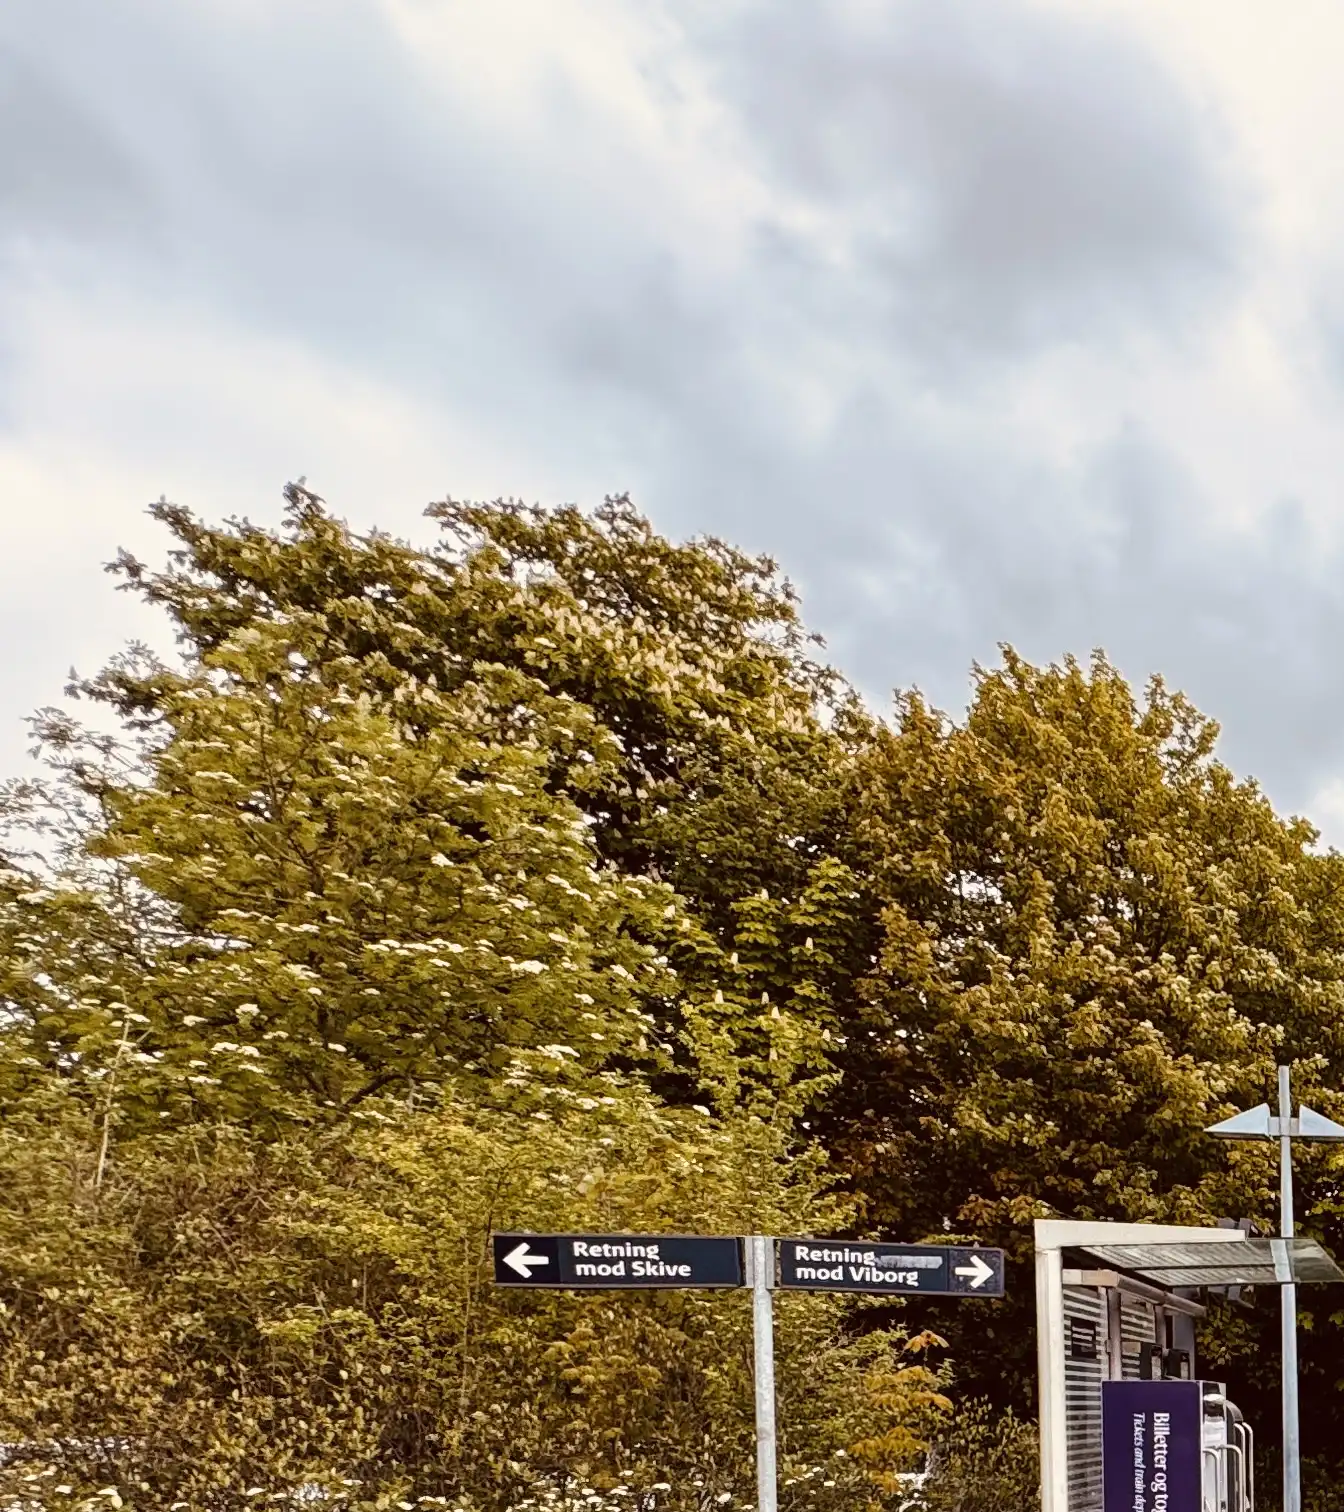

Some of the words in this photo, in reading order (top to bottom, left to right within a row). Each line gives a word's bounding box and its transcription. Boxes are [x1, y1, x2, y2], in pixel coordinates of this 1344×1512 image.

[573, 1241, 660, 1260] Retning
[795, 1245, 876, 1266] Retning
[575, 1260, 626, 1276] mod
[631, 1260, 692, 1276] Skive
[796, 1266, 844, 1281] mod
[848, 1266, 920, 1287] Viborg
[1133, 1412, 1146, 1447] Tickets
[1153, 1412, 1170, 1471] Billetter
[1134, 1447, 1147, 1469] and
[1134, 1469, 1147, 1493] train
[1150, 1472, 1167, 1492] og
